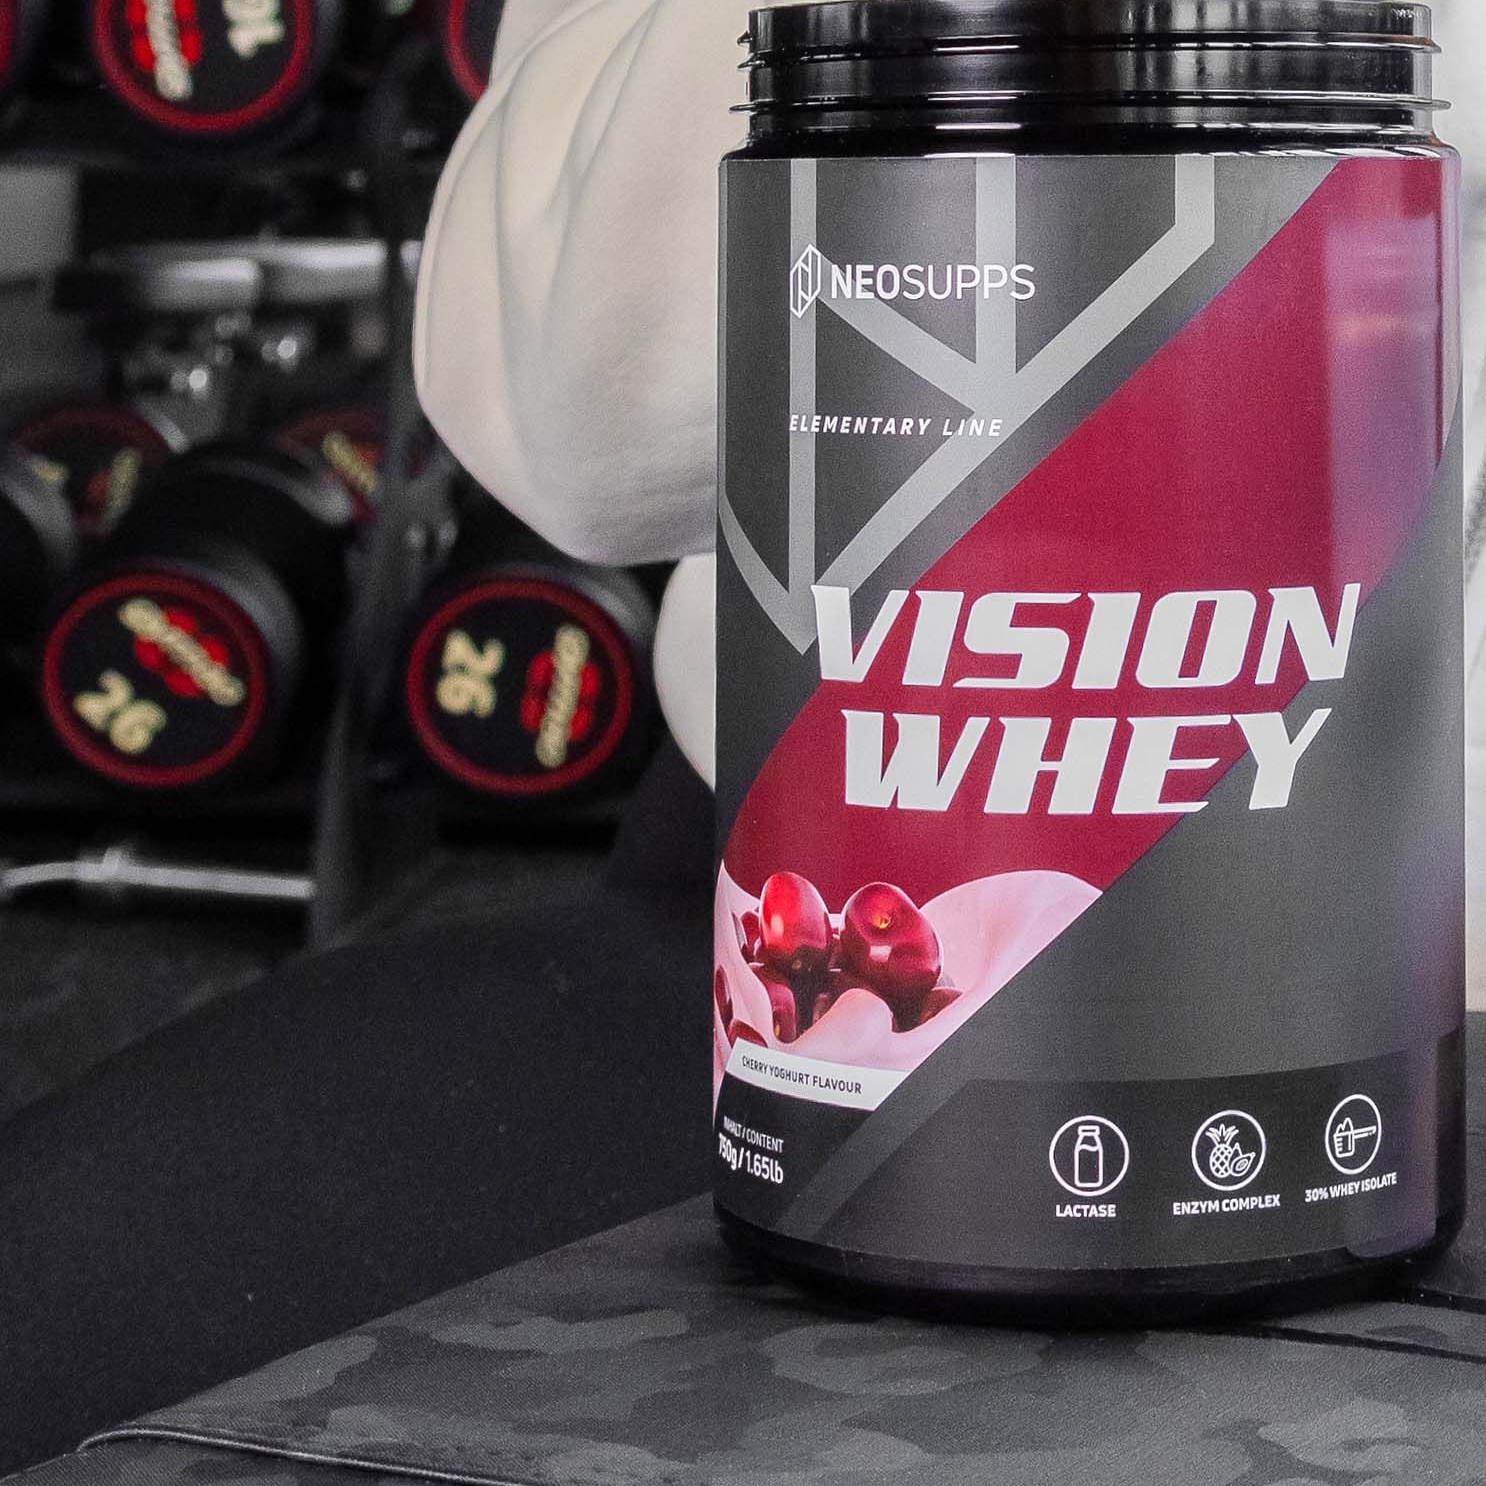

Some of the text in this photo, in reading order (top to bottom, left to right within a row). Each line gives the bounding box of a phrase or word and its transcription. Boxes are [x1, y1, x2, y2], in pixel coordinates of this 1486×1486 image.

[830, 263, 1036, 301] NEOSUPPS
[788, 414, 1003, 437] ELEMENTARY LINE
[811, 583, 1361, 689] VISION
[436, 628, 505, 718] 26
[73, 669, 167, 755] 26
[840, 708, 1332, 815] WHEY
[741, 1055, 862, 1095] CHERRY YOGHURT FLAVOUR
[745, 1128, 785, 1154] CONTENT
[745, 1150, 784, 1184] 1.65lb
[1172, 1193, 1281, 1216] ENZYM COMPLEX
[1304, 1171, 1397, 1203] 30% WHEY ISOLATE
[1055, 1204, 1117, 1218] LACTASE
